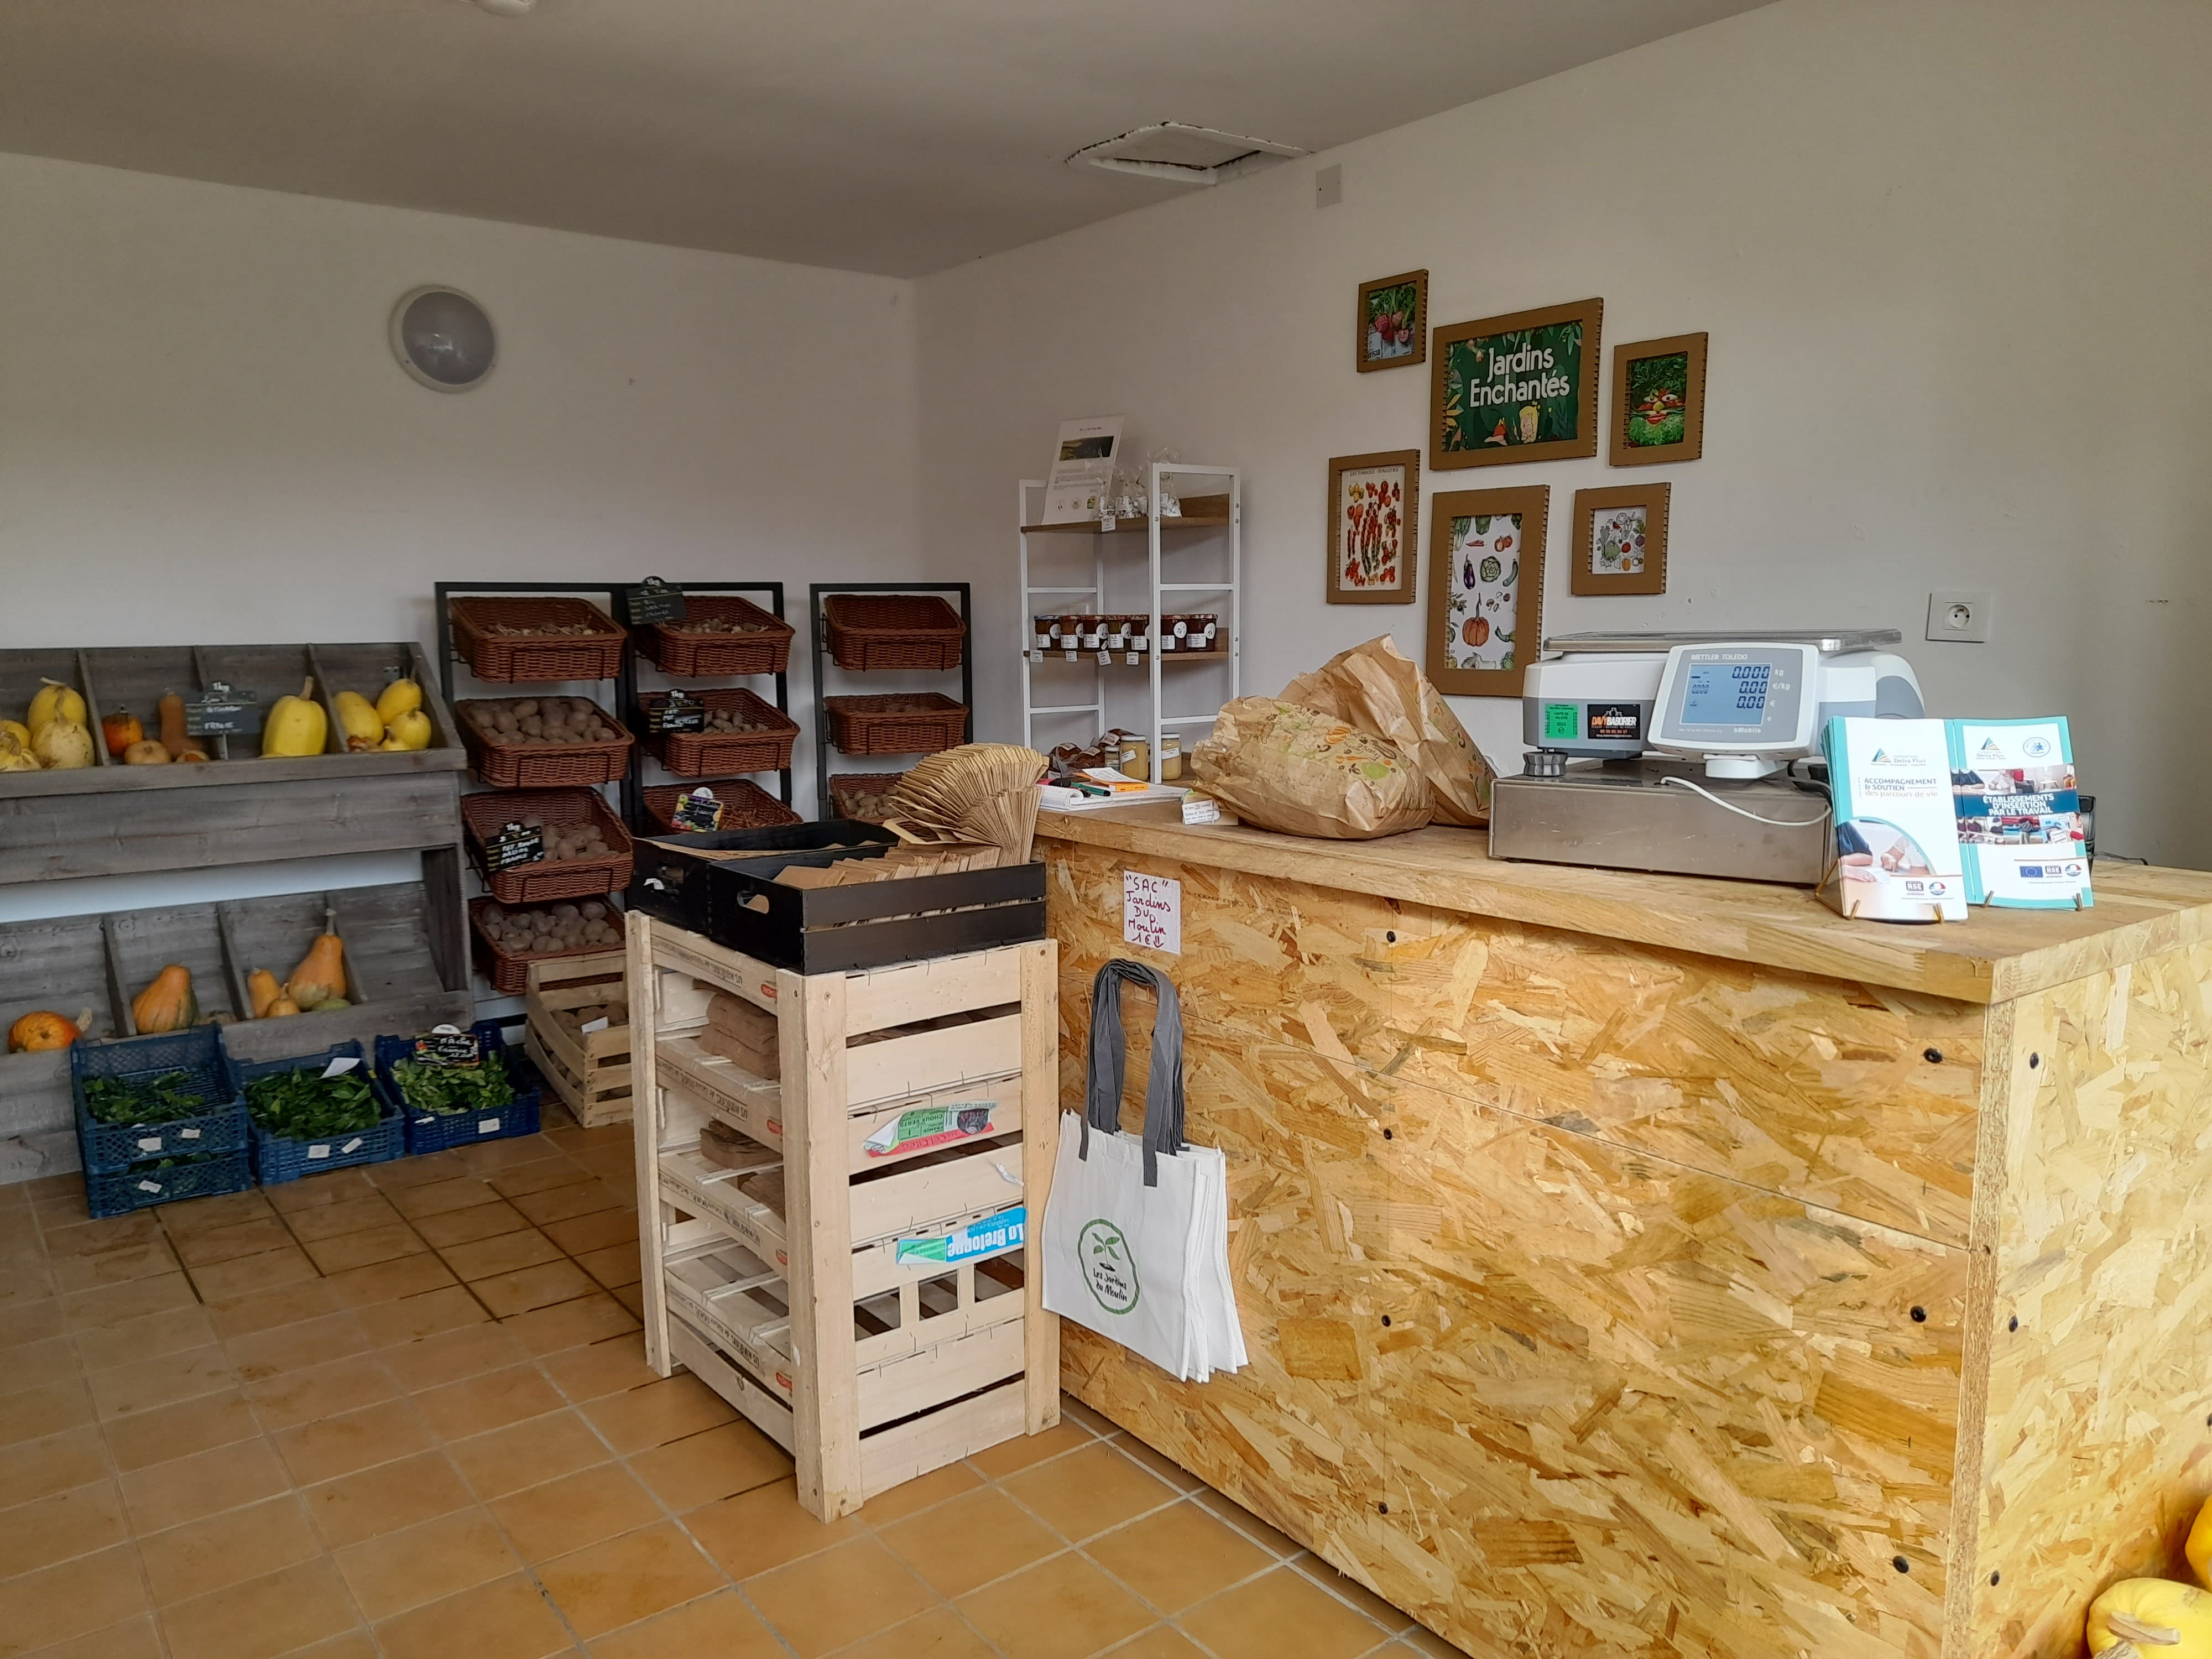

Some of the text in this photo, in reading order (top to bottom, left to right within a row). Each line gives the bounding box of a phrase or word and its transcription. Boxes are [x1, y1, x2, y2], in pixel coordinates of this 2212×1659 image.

[1487, 342, 1554, 383] Jardins
[1470, 369, 1571, 408] Enchantés
[646, 577, 660, 586] 1kg
[212, 681, 230, 692] 1kg
[670, 690, 684, 698] 1kg
[1983, 793, 2054, 804] ÉTABLISSEMENTS
[1992, 801, 2047, 810] D'INSERTION
[2017, 806, 2053, 815] TRAVAIL
[505, 823, 520, 831] 1kg
[1126, 891, 1171, 912] Jardins
[1134, 906, 1150, 917] DU
[1128, 914, 1167, 935] Moulin
[922, 1114, 943, 1124] CHOUX
[1093, 1267, 1127, 1291] Les Jardins
[1096, 1279, 1127, 1302] du Moulin
